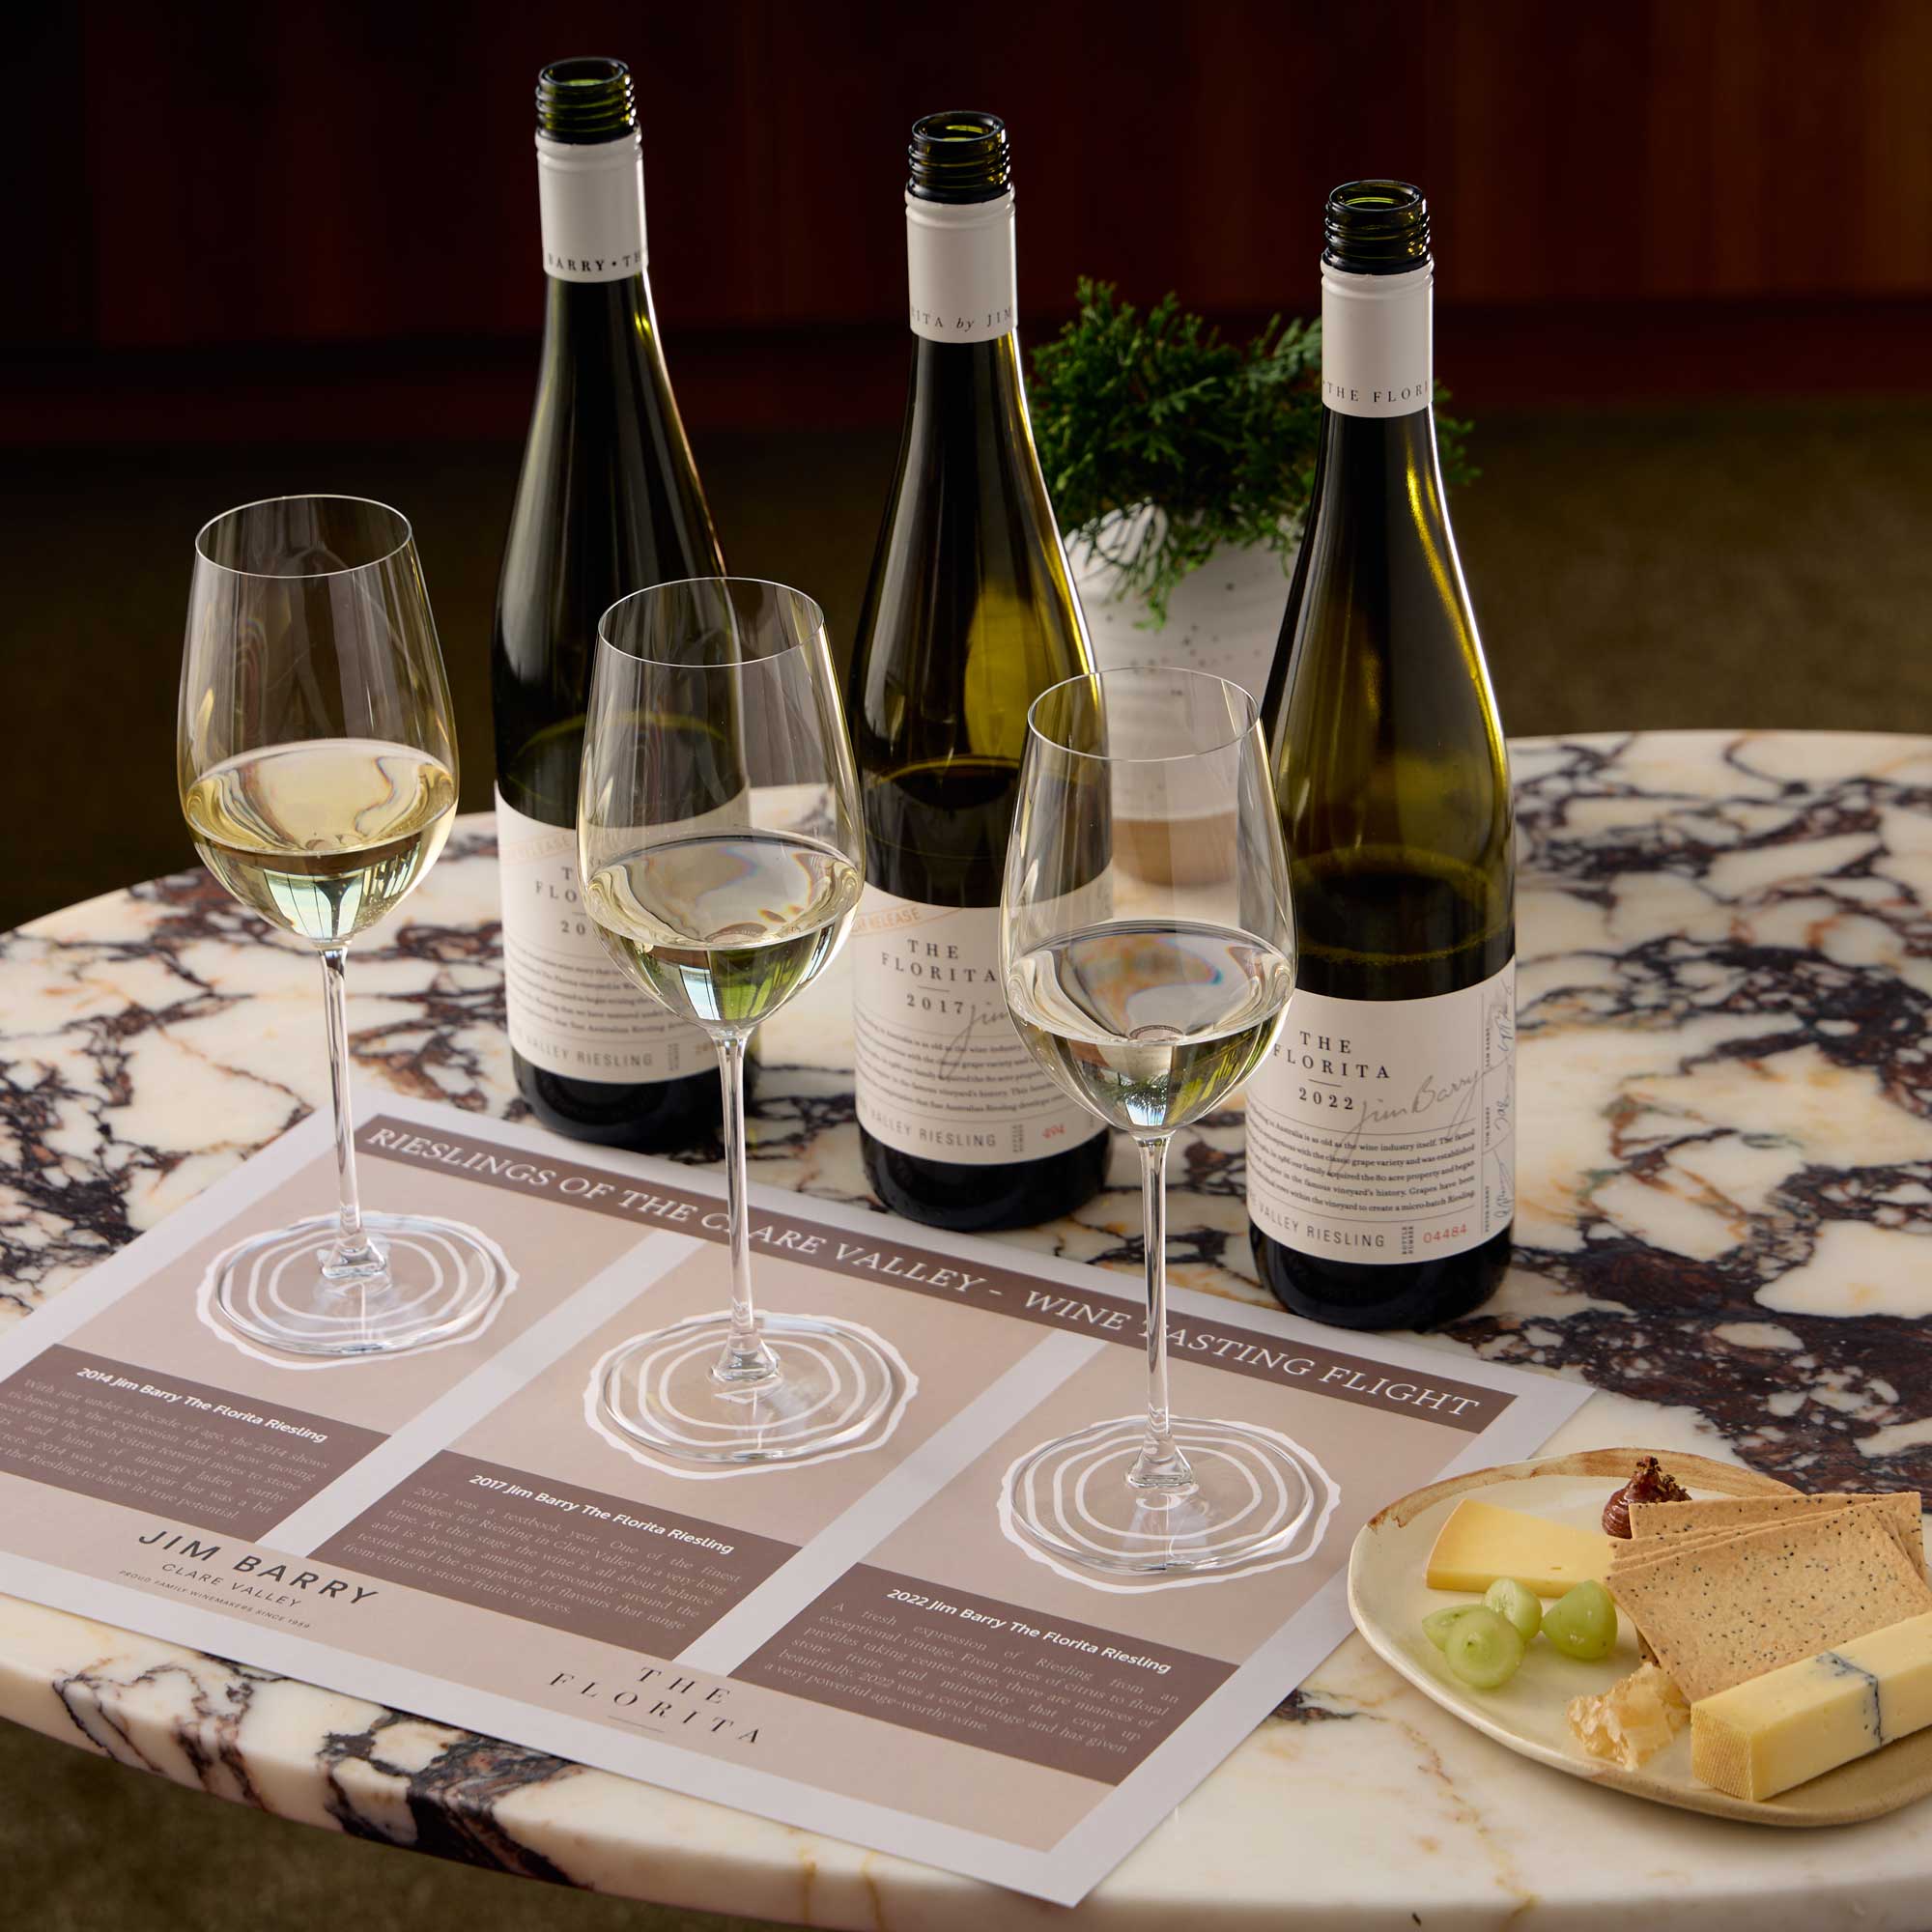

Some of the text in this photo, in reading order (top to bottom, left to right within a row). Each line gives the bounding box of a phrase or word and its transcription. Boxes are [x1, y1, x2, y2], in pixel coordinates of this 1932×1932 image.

[956, 317, 975, 332] by
[1327, 381, 1359, 402] THE
[881, 952, 997, 982] FLORITA
[907, 938, 959, 960] THE
[906, 993, 963, 1014] 2017
[577, 1051, 653, 1068] RIESLING
[1273, 1042, 1390, 1080] FLORITA
[1299, 1030, 1351, 1054] THE
[1298, 1087, 1353, 1110] 2022
[920, 1128, 997, 1148] RIESLING
[1380, 1143, 1414, 1152] industry
[1333, 1186, 1374, 1197] vineyard's
[1408, 1186, 1437, 1195] Grapes
[1406, 1170, 1439, 1182] property
[1325, 1200, 1357, 1210] vineyard
[1259, 1204, 1385, 1248] VALLEY RIESLING
[1423, 1221, 1467, 1244] 04484
[365, 1127, 557, 1186] RIESLINGS
[558, 1176, 616, 1200] OF
[617, 1189, 699, 1222] THE
[700, 1212, 828, 1255] CARE
[834, 1242, 988, 1293] VALLEY
[1024, 1290, 1133, 1331] WINE
[1319, 1365, 1481, 1416] FLIGHT
[75, 1367, 327, 1442] 2014 Jim Barry The Florita Riesling
[468, 1474, 734, 1554] 2017 Jim Barry The Florita Riesling
[384, 1510, 714, 1605] time. At this stage the wine is all about balance
[400, 1499, 454, 1518] vintages
[455, 1513, 479, 1524] for
[477, 1520, 533, 1541] Riesling
[533, 1534, 551, 1545] in
[552, 1541, 590, 1555] Clare
[594, 1550, 636, 1569] Valley
[635, 1563, 652, 1574] in
[666, 1573, 696, 1585] very
[695, 1578, 727, 1595] long
[138, 1530, 379, 1605] JIM BARRY
[161, 1562, 302, 1608] CLARE VALLEY
[119, 1569, 151, 1584] PROUD
[154, 1579, 188, 1594] FAMILY
[189, 1590, 253, 1613] WINEMAKERS
[254, 1608, 286, 1623] SINCE
[886, 1589, 1172, 1674] 2022 Jim Barry The Florita Riesling
[818, 1616, 1170, 1716] exceptional vintage. From notes of citrus to floral
[831, 1603, 1179, 1704] A fresh expression of Riesling from an
[637, 1666, 731, 1705] THE
[790, 1639, 1142, 1742] stone fruits and minerality that crop up
[549, 1672, 761, 1744] FLORITA
